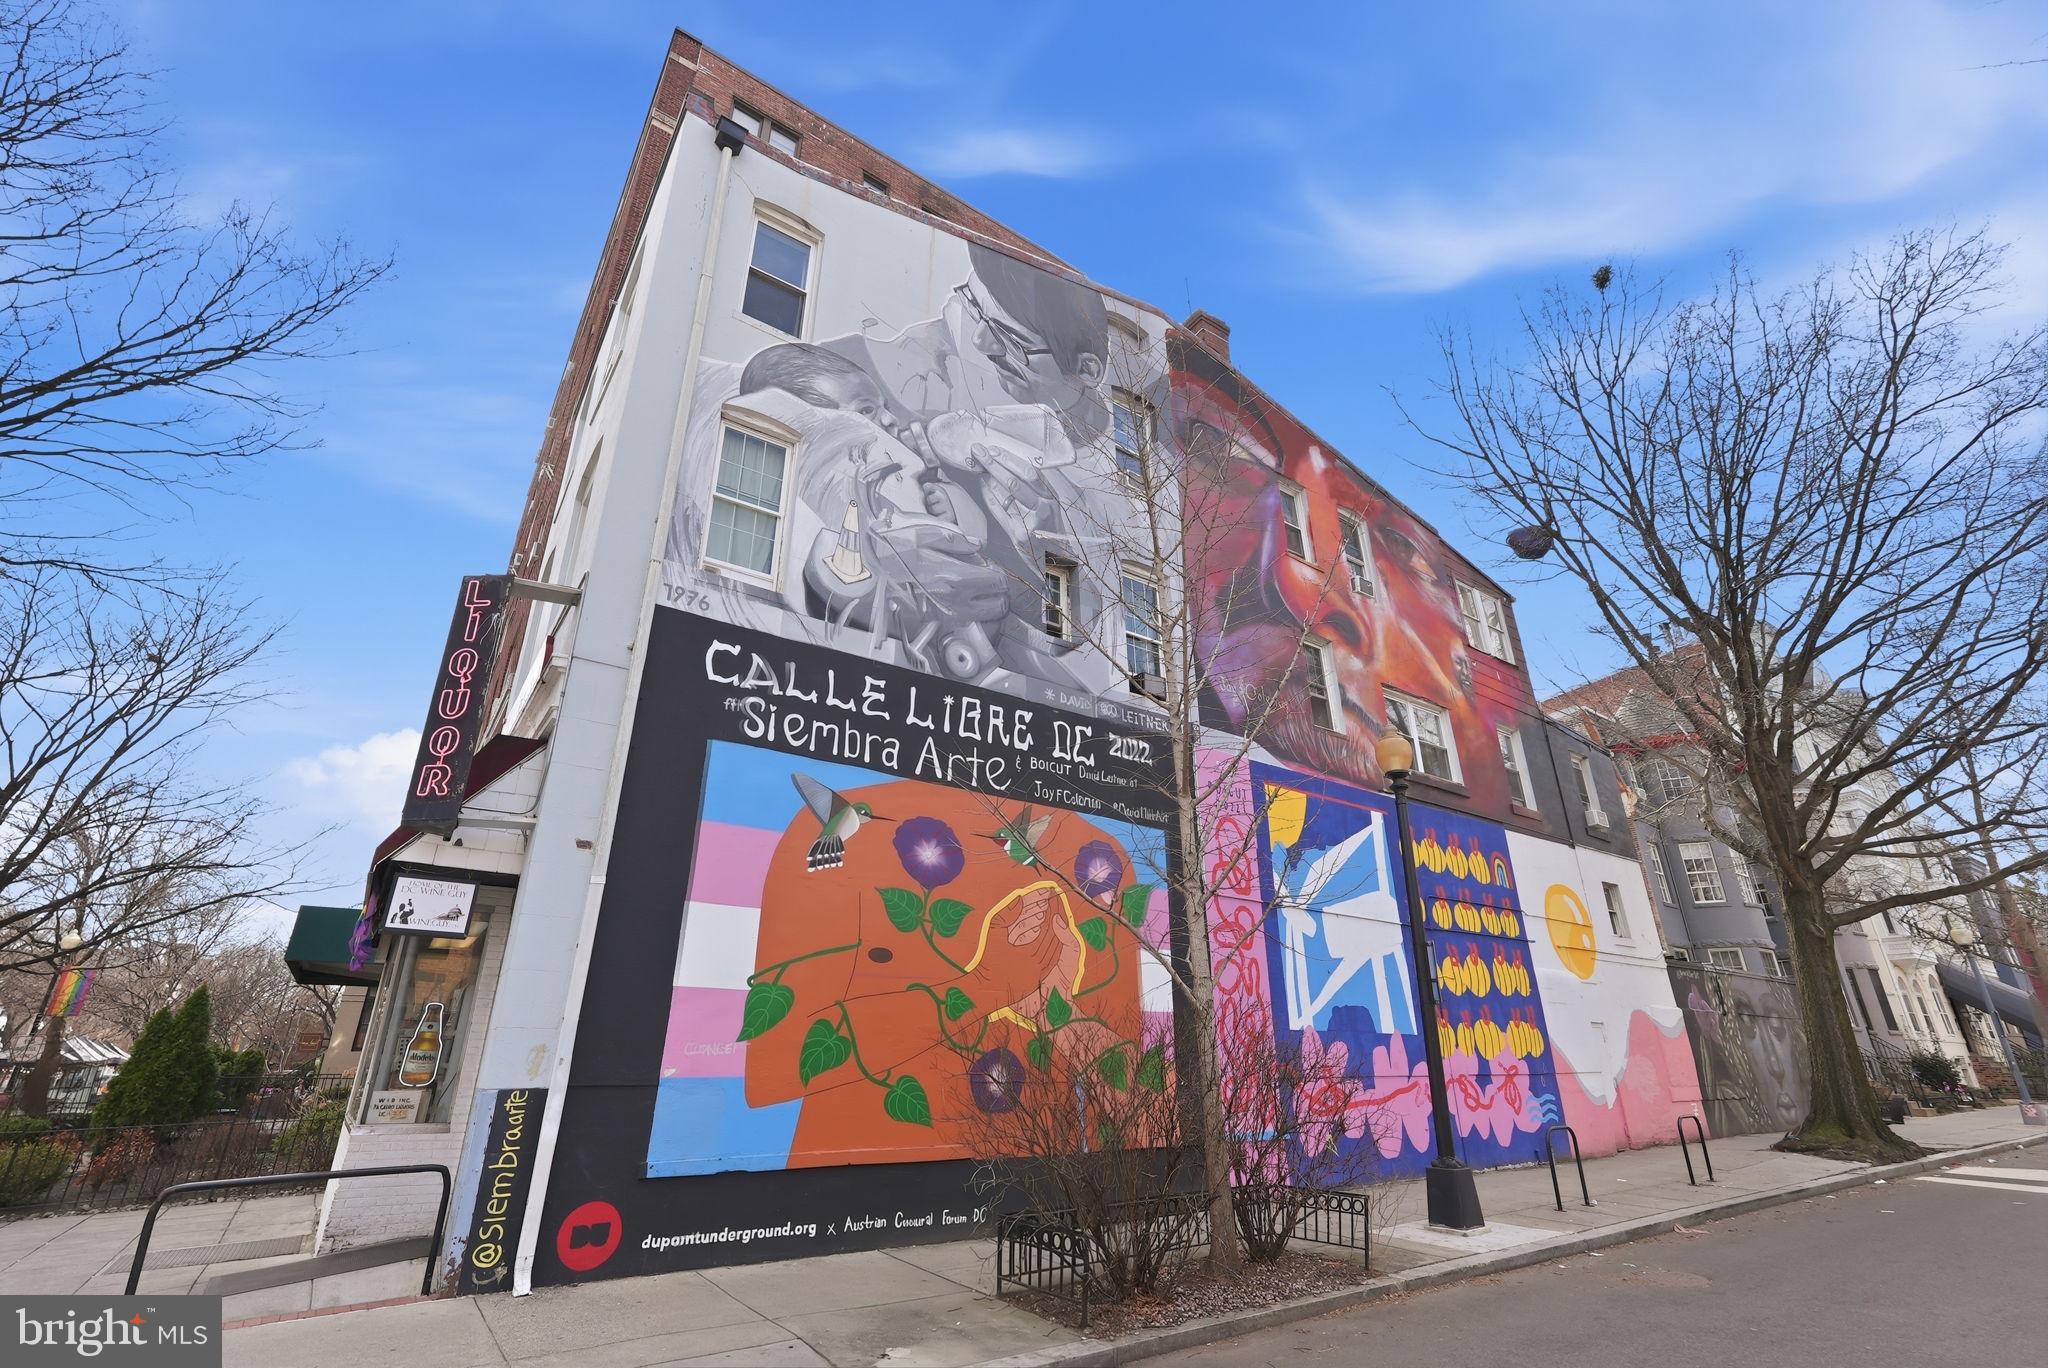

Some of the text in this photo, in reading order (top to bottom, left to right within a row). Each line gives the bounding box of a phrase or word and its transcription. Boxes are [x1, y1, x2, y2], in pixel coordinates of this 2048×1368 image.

[663, 583, 710, 611] 1976
[416, 580, 491, 796] LIQUOR
[705, 639, 891, 720] CALLE
[1051, 721, 1096, 767] DC
[1108, 732, 1153, 767] 2022
[740, 697, 901, 770] Siembra
[914, 736, 1012, 791] Arte
[420, 887, 445, 897] WINE
[447, 891, 467, 899] GUY
[844, 1215, 887, 1232] Austrian
[973, 1207, 987, 1224] DC
